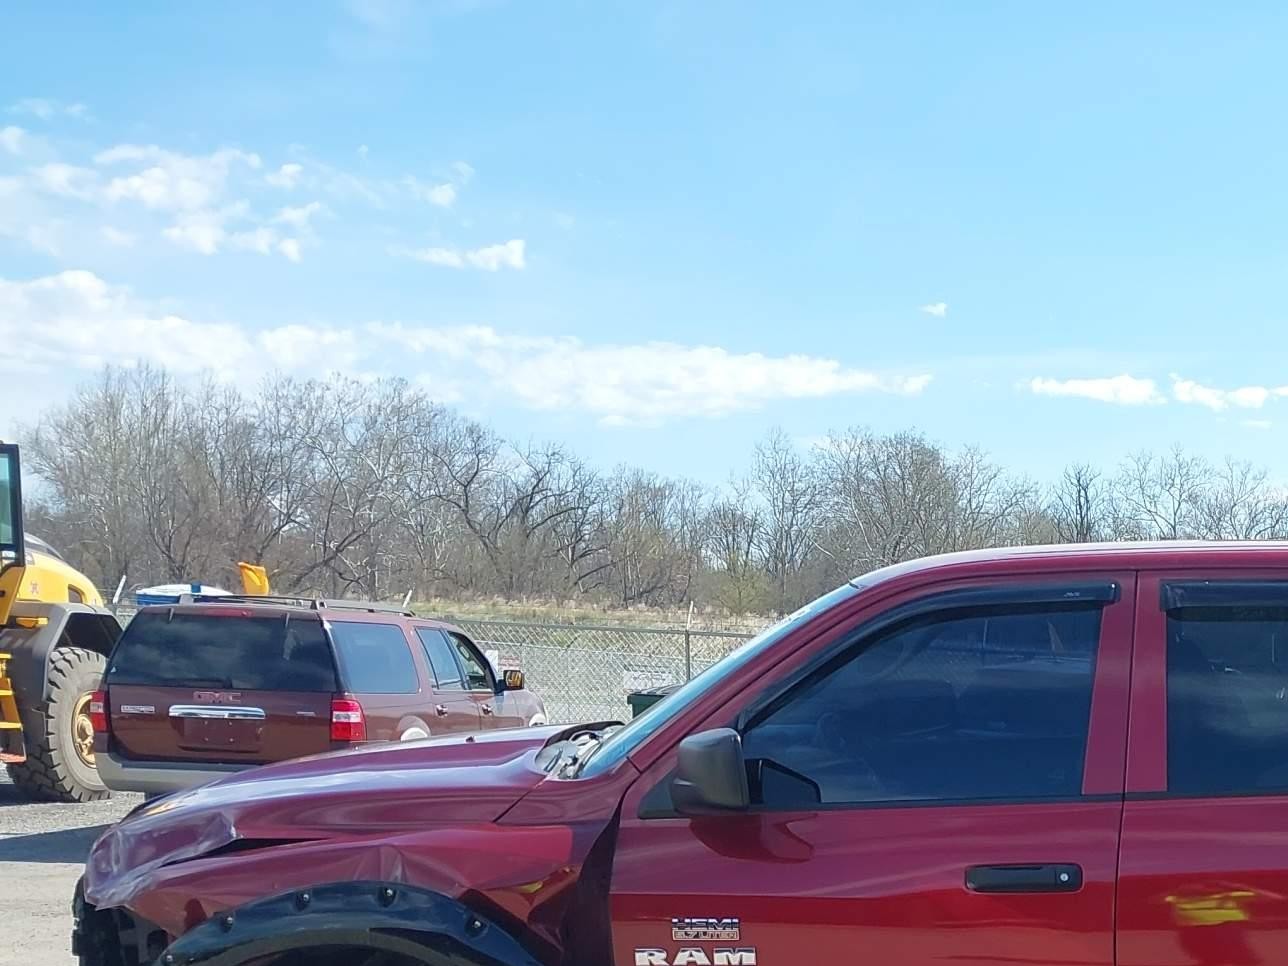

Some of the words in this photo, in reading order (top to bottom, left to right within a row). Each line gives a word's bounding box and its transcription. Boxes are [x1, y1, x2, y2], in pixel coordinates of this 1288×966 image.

[193, 691, 241, 704] GMC
[671, 918, 739, 931] HEMI
[634, 947, 757, 966] RAM
